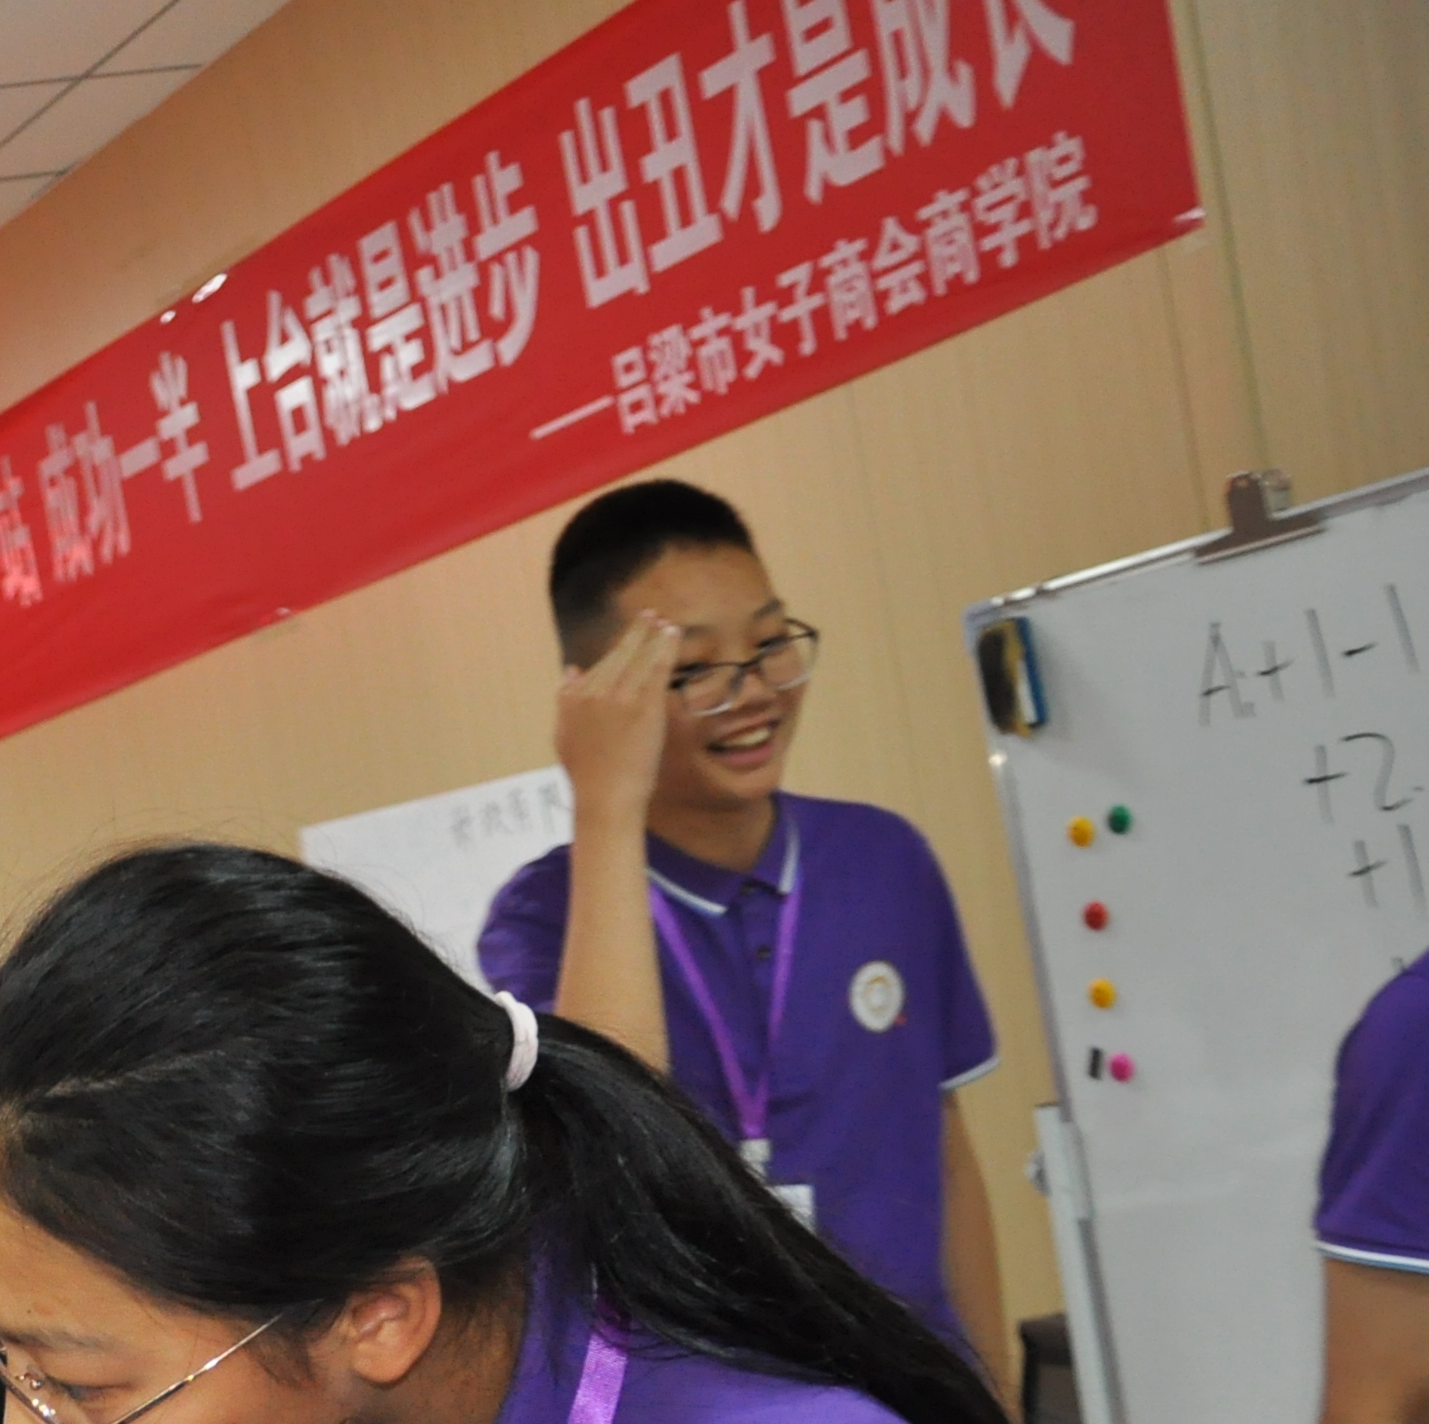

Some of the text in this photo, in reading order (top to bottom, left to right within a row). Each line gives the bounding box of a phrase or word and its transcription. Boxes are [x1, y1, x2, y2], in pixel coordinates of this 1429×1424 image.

[39, 350, 210, 583] 成功一半
[221, 147, 541, 490] 上台就是进步
